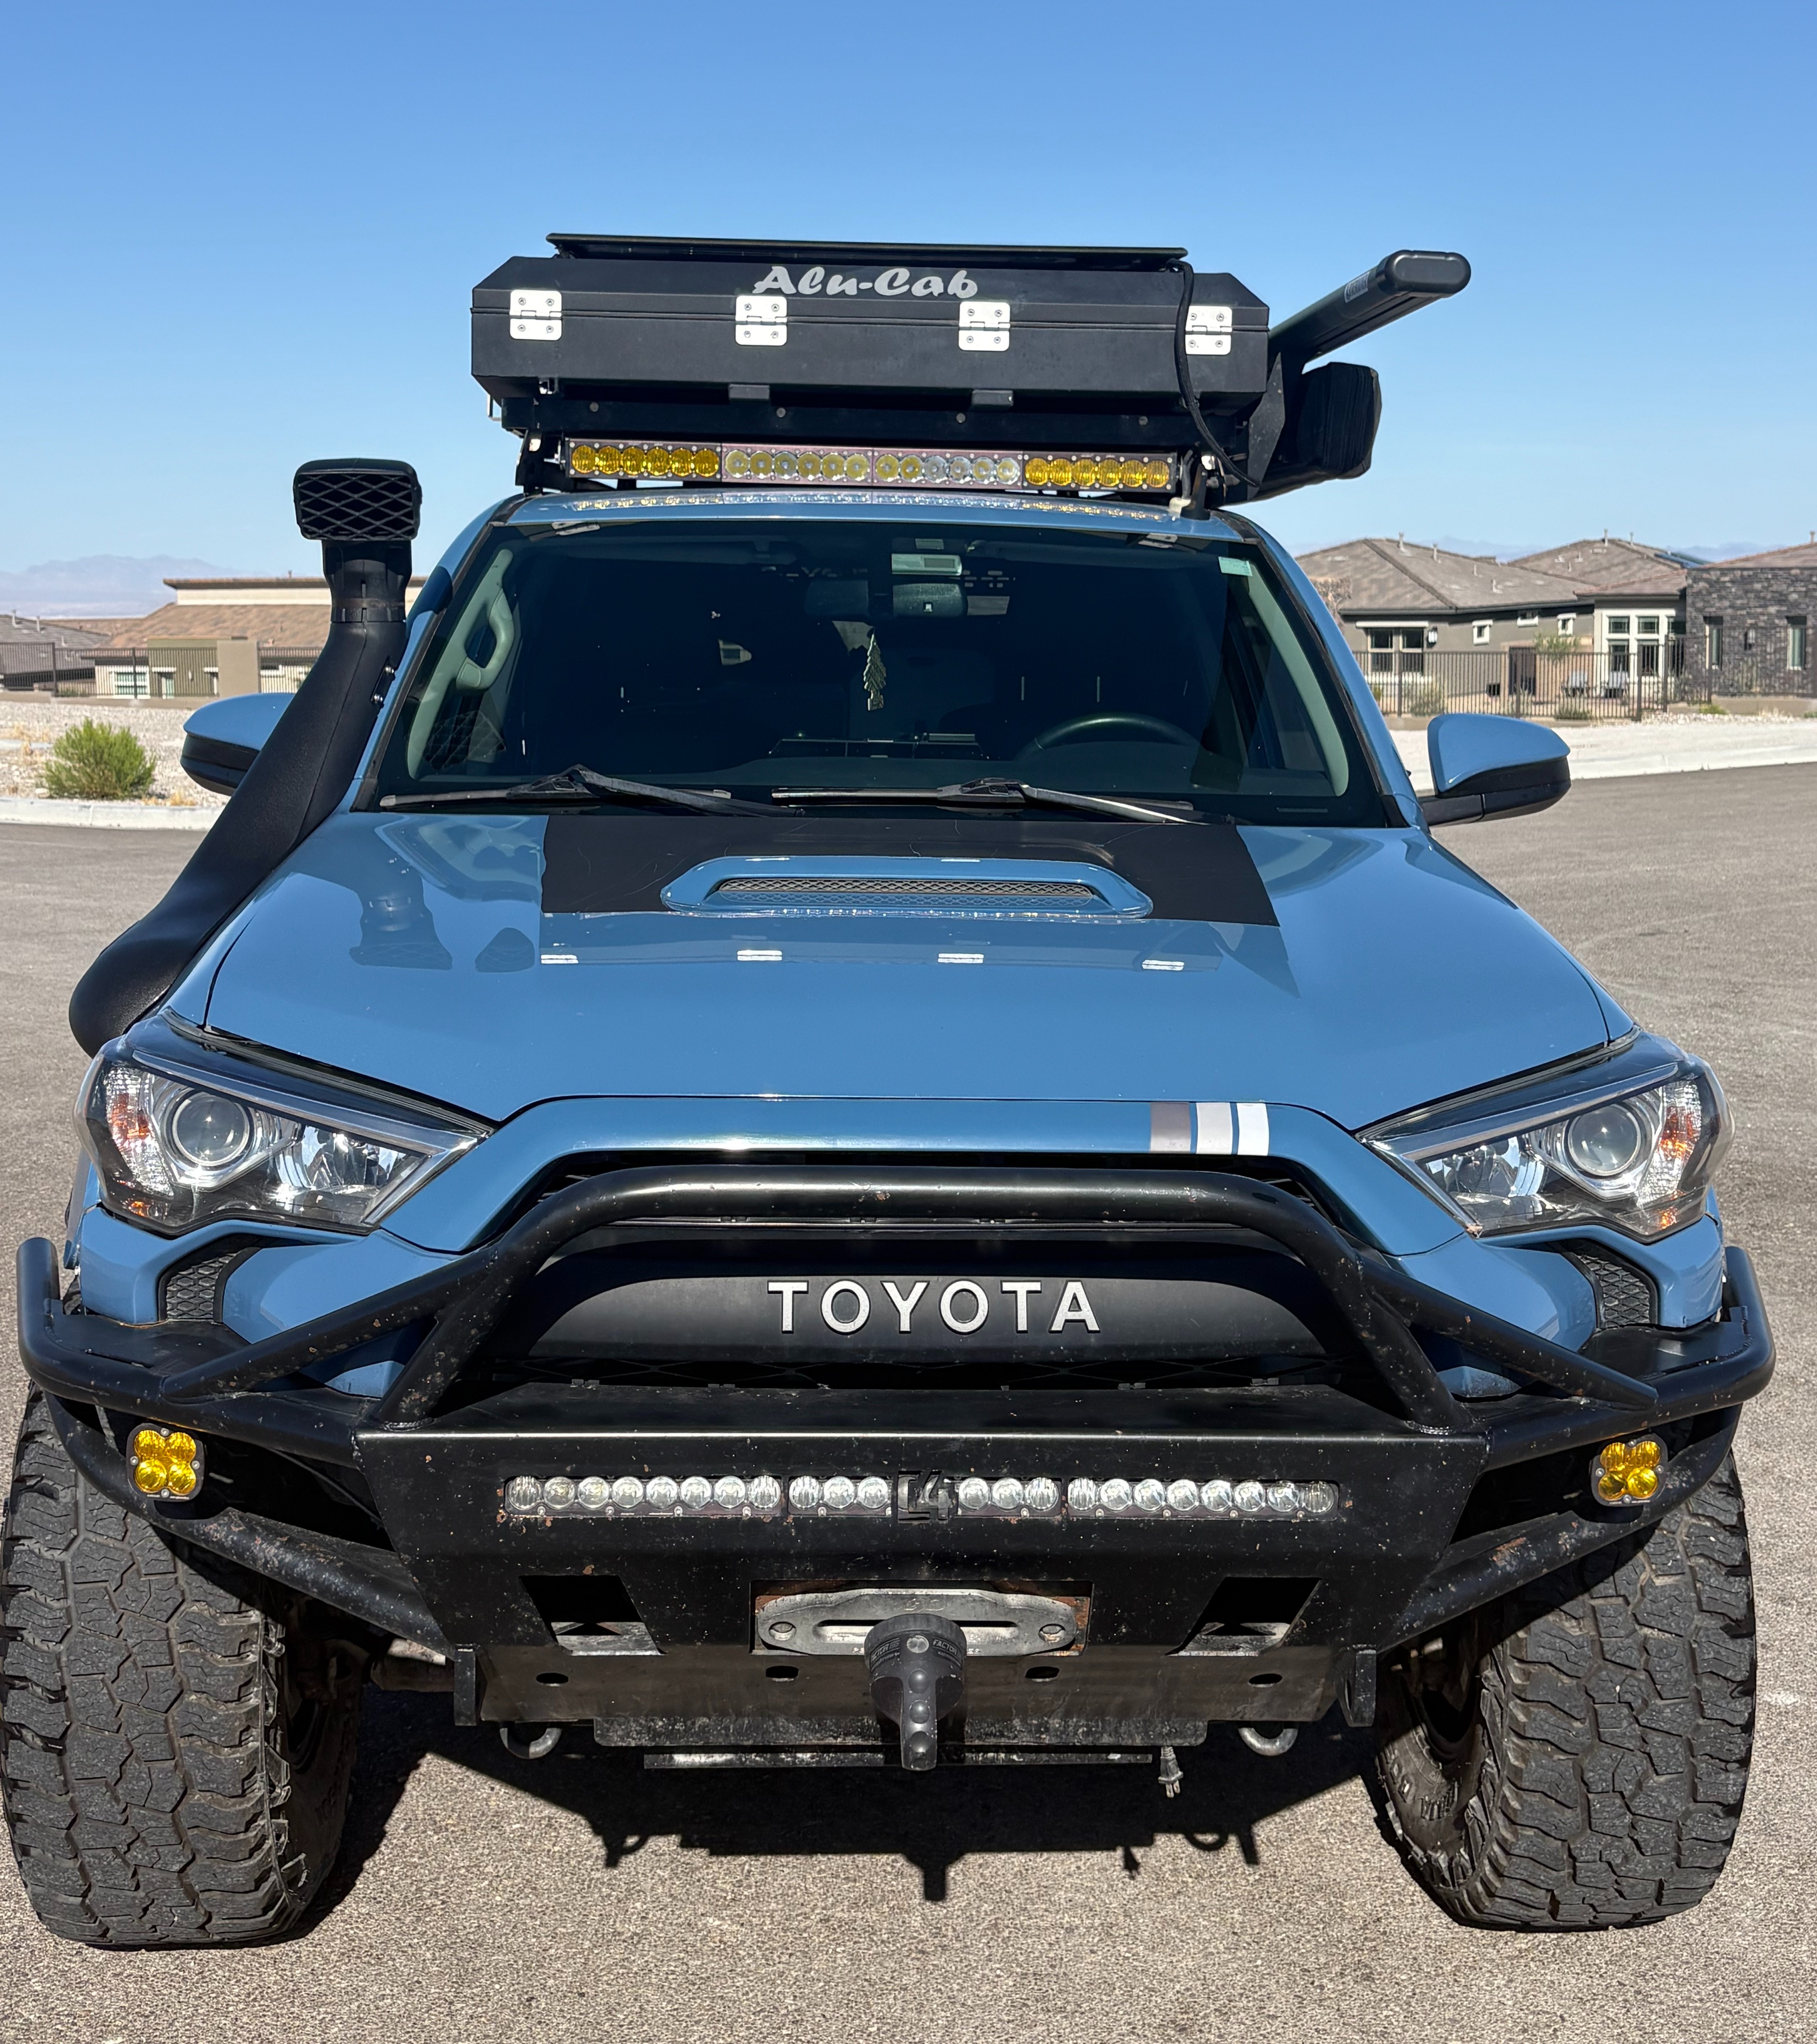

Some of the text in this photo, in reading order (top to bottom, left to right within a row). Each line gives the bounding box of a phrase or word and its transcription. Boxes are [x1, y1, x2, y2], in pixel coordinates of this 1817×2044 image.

[752, 266, 978, 298] Alu-Cab
[768, 1280, 1100, 1335] TOYOTA
[933, 1639, 957, 1655] FACTOR
